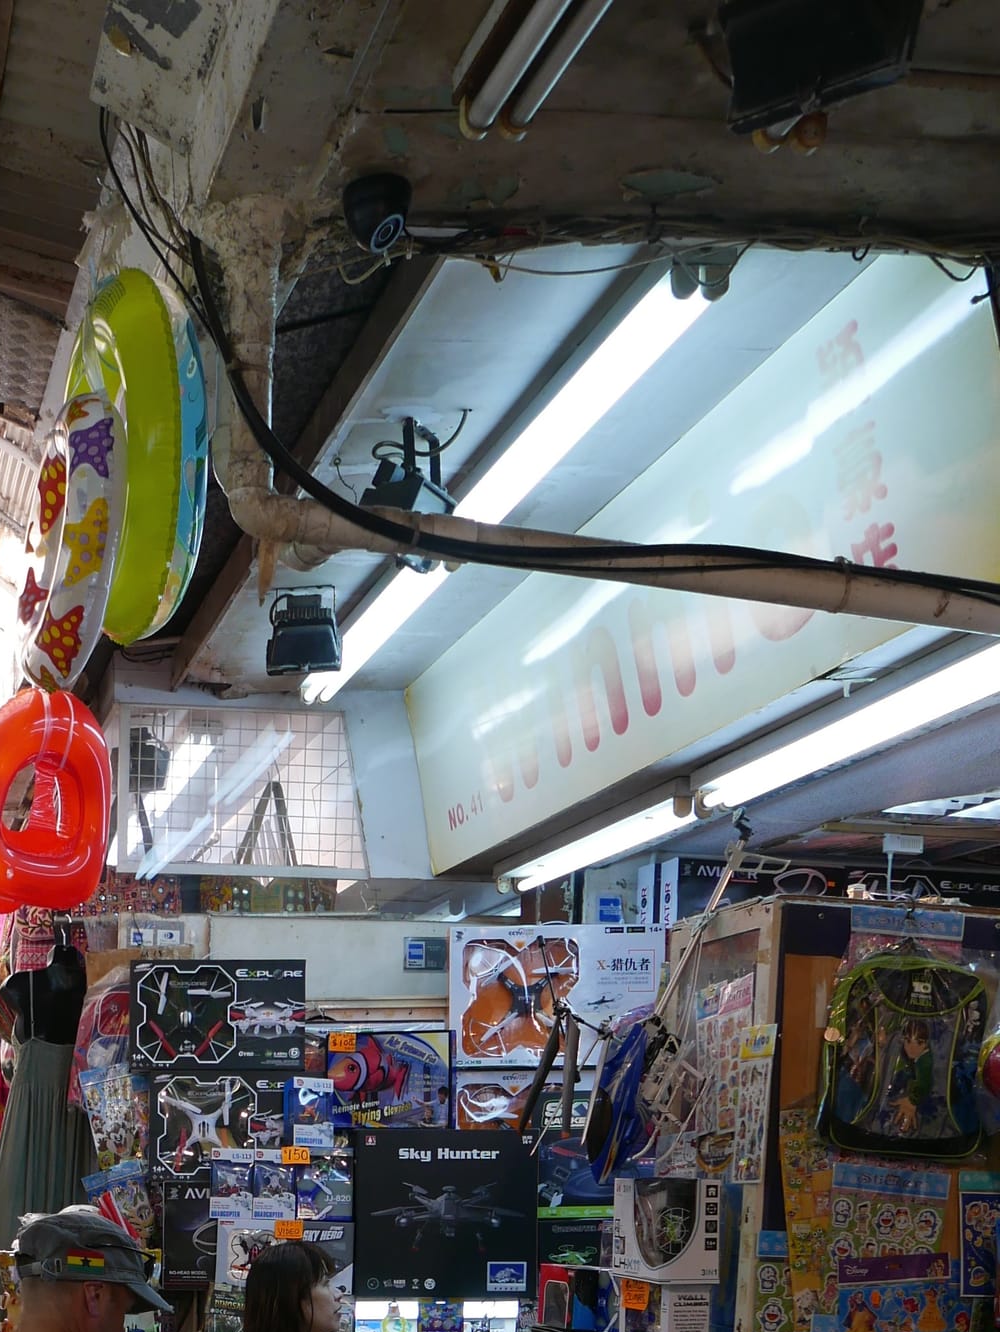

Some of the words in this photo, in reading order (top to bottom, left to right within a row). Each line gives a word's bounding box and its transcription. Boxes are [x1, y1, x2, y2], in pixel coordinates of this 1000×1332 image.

[448, 802, 469, 831] NO.
[470, 791, 484, 816] 41
[399, 1148, 432, 1162] Sky
[437, 1148, 500, 1160] Hunter
[320, 1229, 345, 1241] HERO
